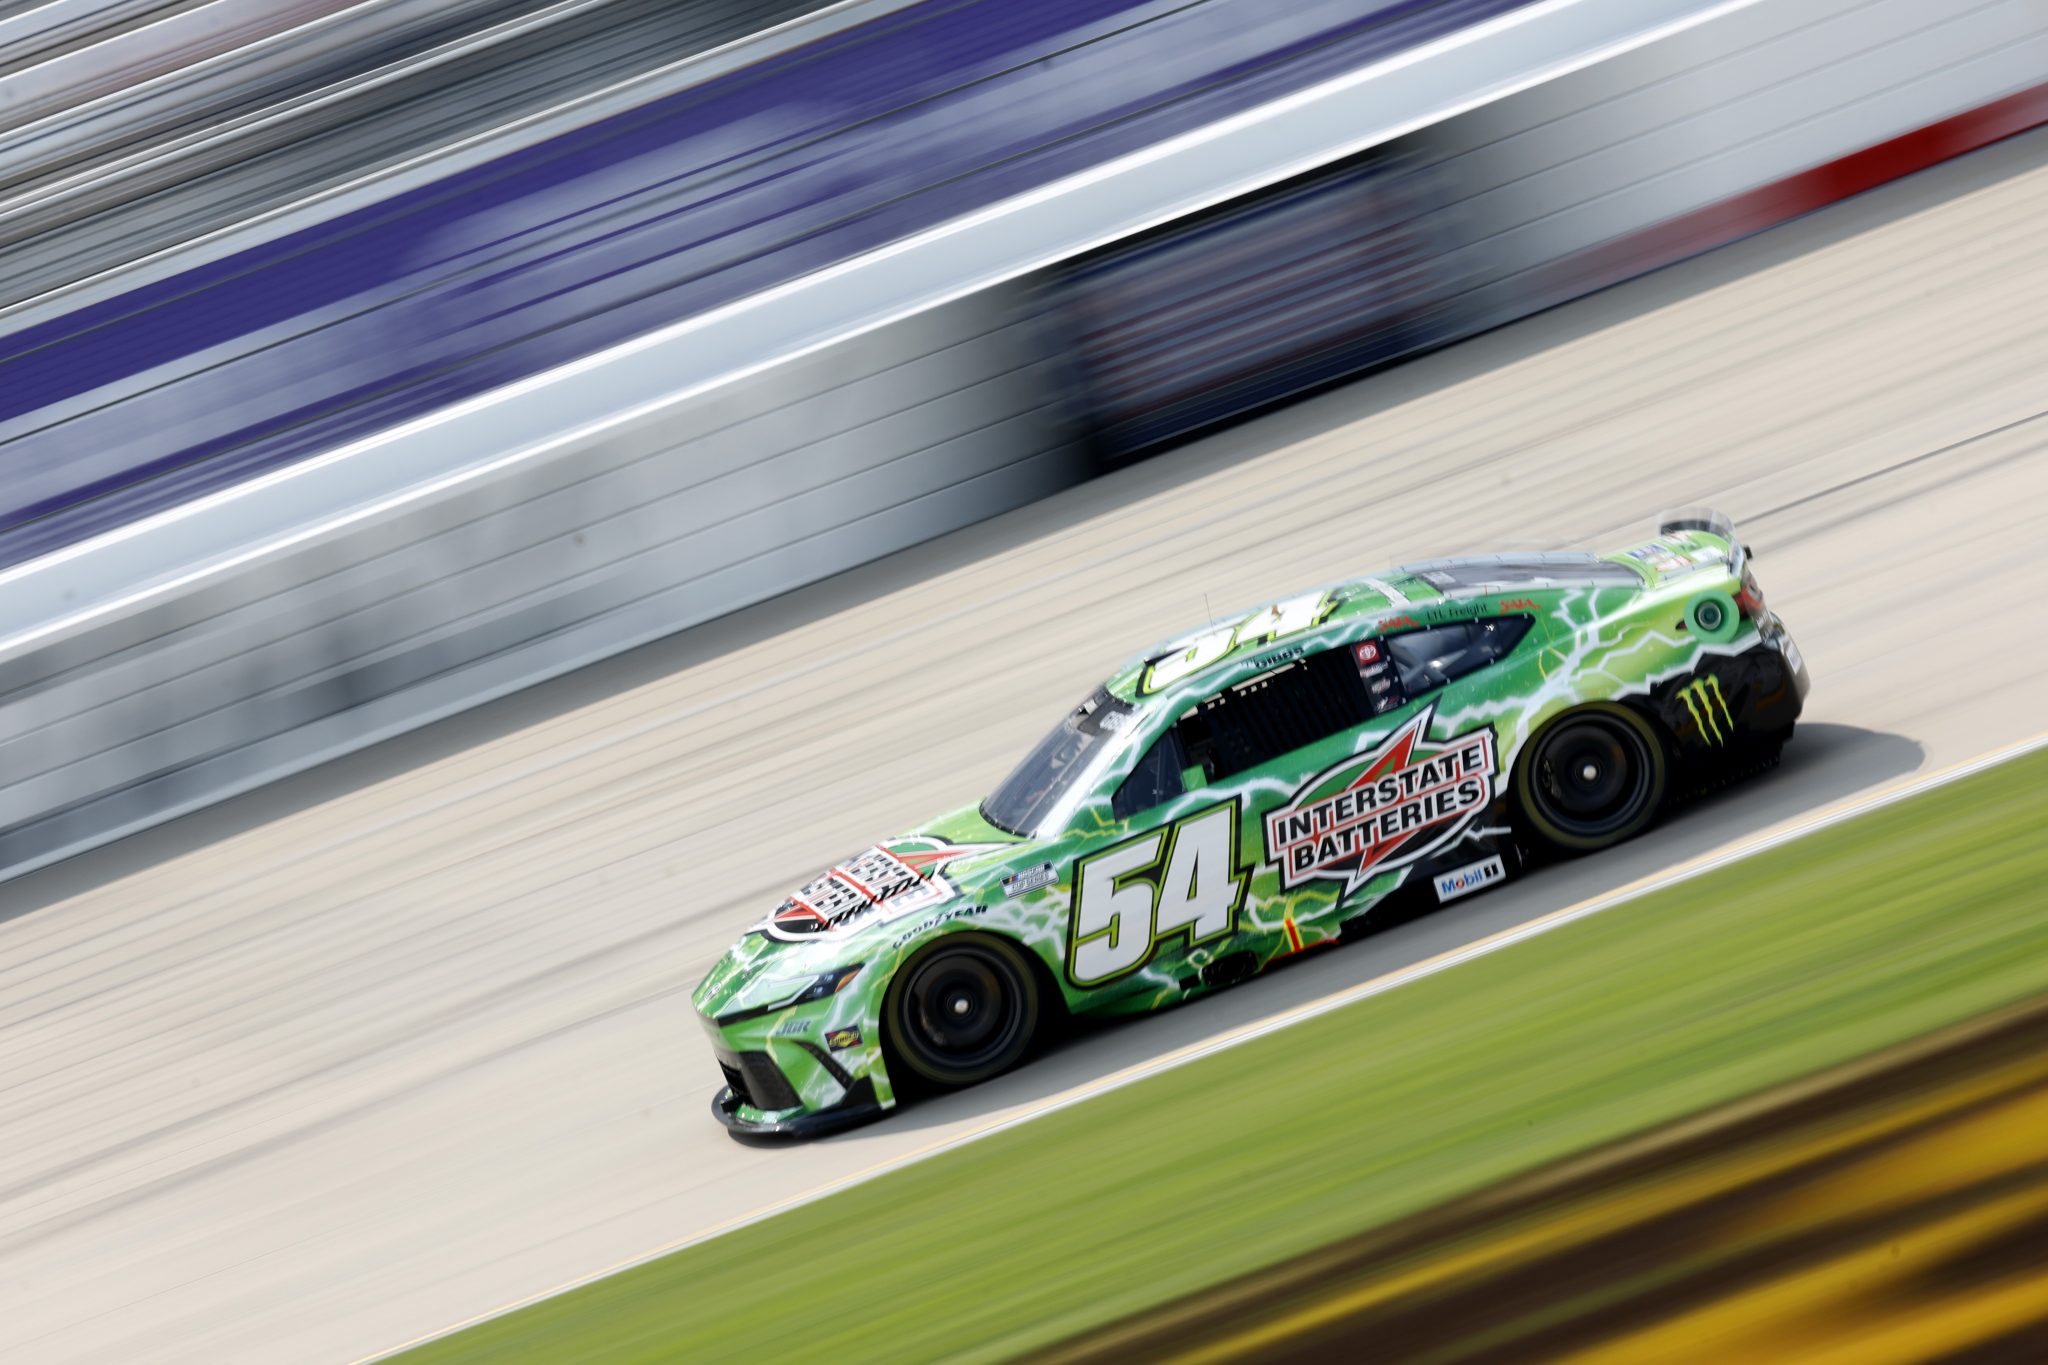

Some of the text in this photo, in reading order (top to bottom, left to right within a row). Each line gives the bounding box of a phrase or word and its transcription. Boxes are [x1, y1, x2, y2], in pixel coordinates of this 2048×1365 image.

[1450, 601, 1489, 619] Freight
[1277, 743, 1484, 846] INTERSTATE
[1294, 778, 1482, 873] BATTERIES
[1068, 799, 1247, 988] 54
[1441, 863, 1499, 895] Mobil 1
[892, 904, 988, 949] GOODYEAR
